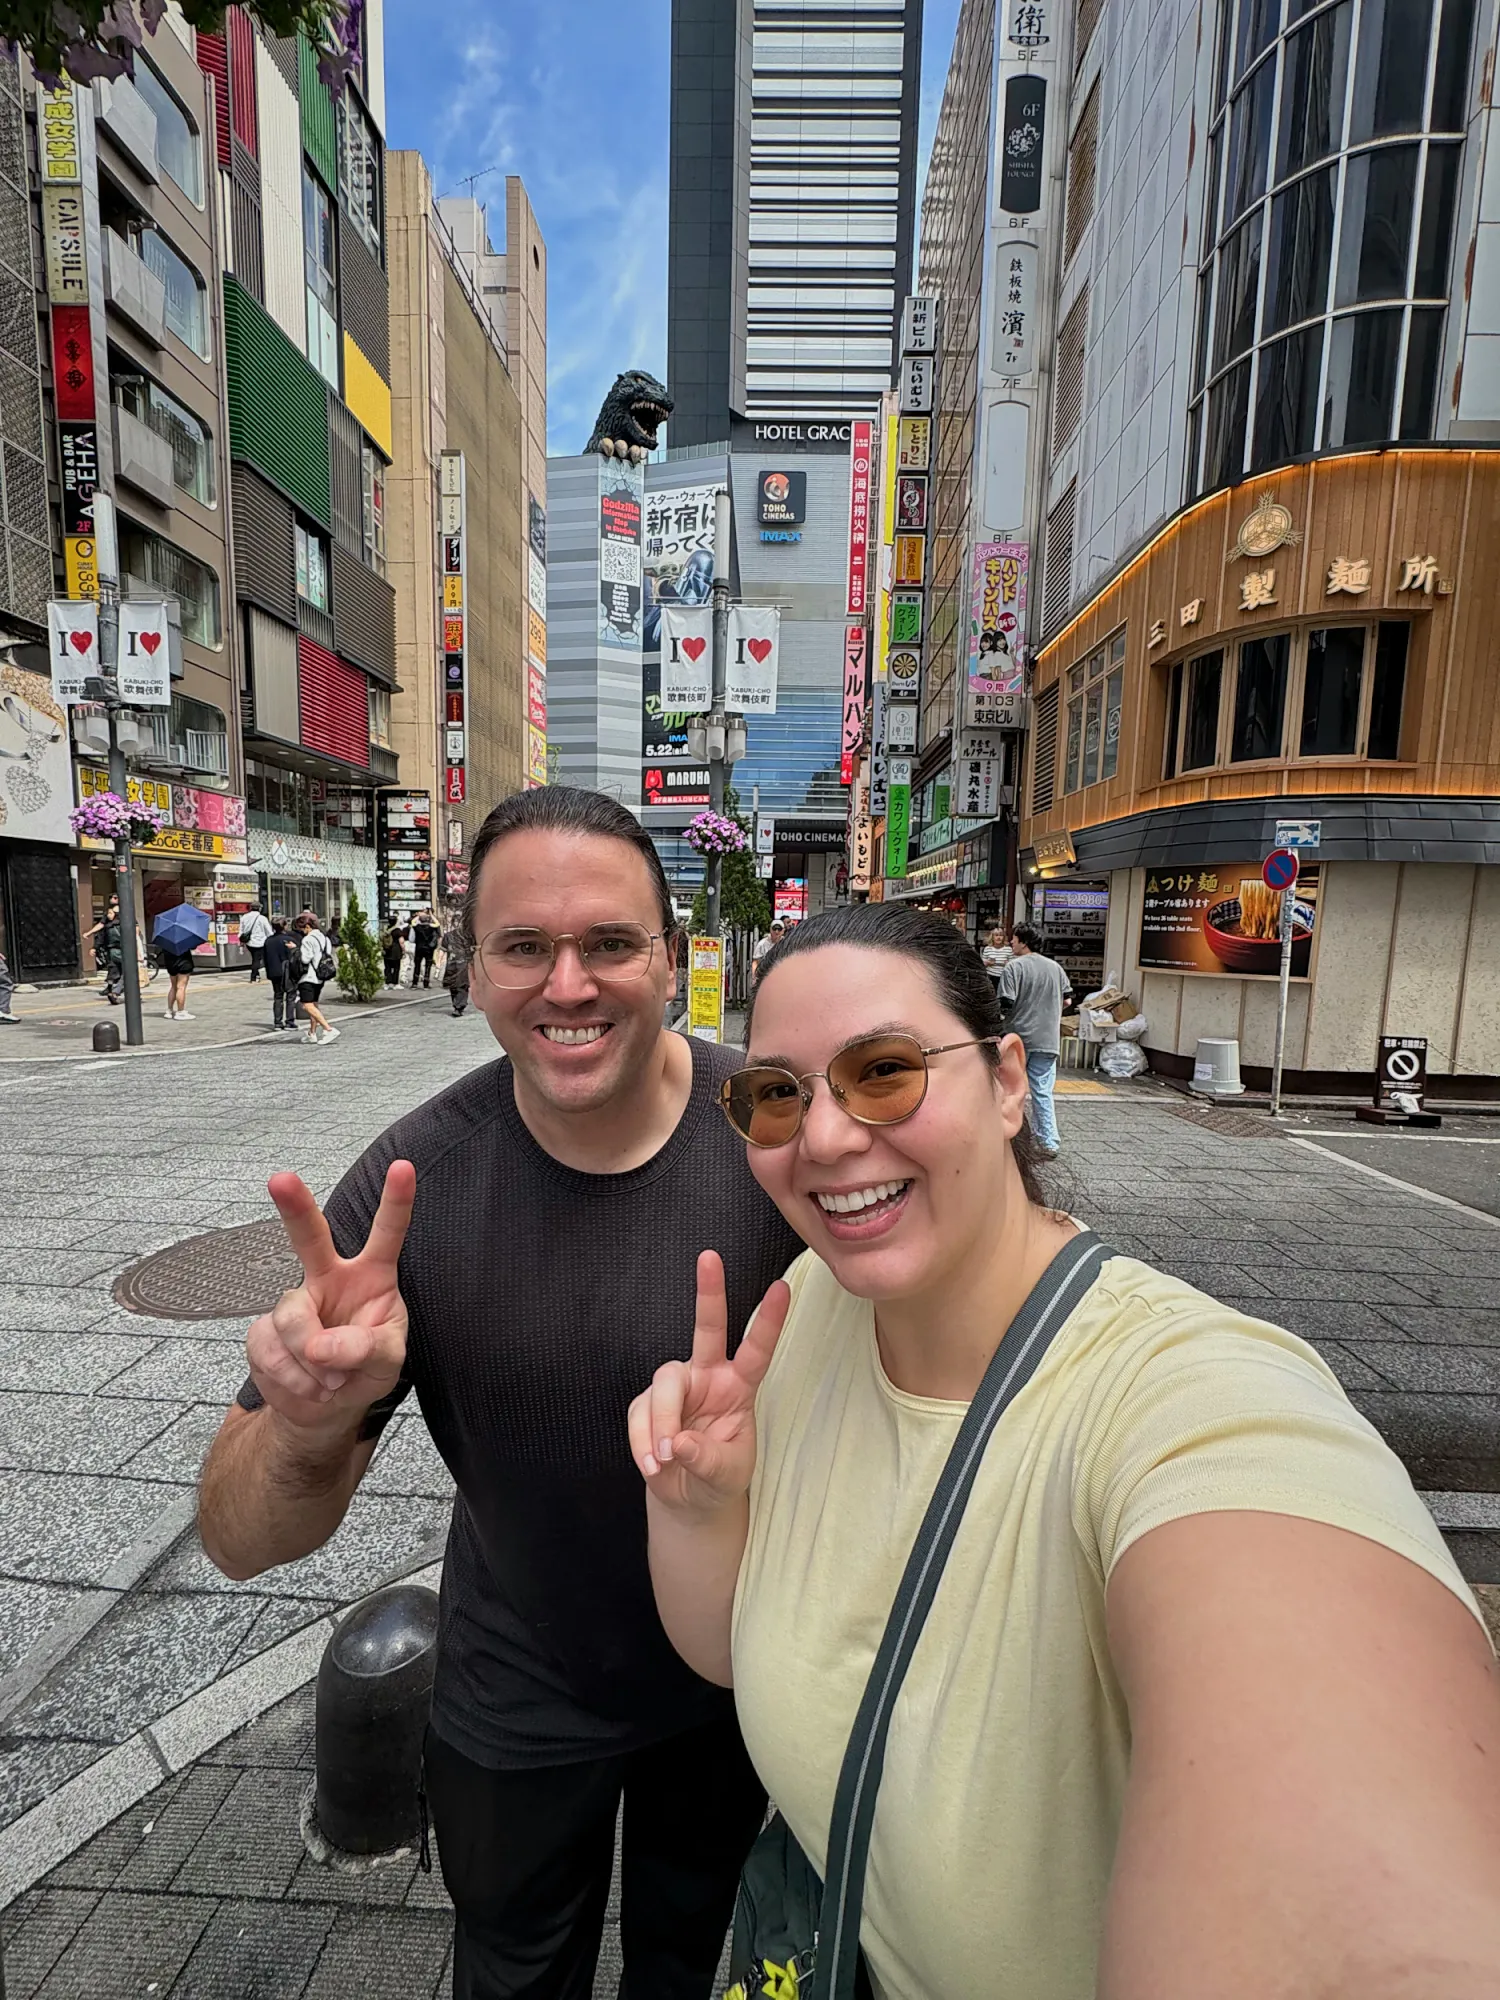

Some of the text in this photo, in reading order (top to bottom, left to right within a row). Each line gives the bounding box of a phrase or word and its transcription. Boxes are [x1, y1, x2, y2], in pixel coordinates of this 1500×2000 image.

[1014, 0, 1046, 34] 衛
[1018, 50, 1039, 61] 5F
[1022, 103, 1040, 117] 6F
[1008, 161, 1035, 169] SHISHA
[1009, 218, 1030, 228] 6F
[58, 198, 83, 290] CAPSULE
[1008, 258, 1023, 304] 鉄板焼
[912, 300, 927, 348] 川新ビル
[1001, 309, 1025, 337] 濱
[1005, 352, 1018, 363] 7F
[910, 361, 923, 407] にいむら
[1001, 378, 1021, 388] 7F
[755, 425, 851, 440] HOTEL GRAC
[63, 434, 74, 456] BAR
[910, 423, 921, 466] ととりこ
[66, 470, 77, 490] PUB
[75, 432, 96, 518] AGEHA
[603, 497, 640, 515] Godzilla
[763, 504, 786, 512] TOHO
[603, 507, 640, 522] Information
[614, 517, 628, 527] Map
[763, 512, 795, 520] CINEMAS
[76, 521, 92, 532] 2F
[607, 532, 635, 543] SCAN HERE
[760, 531, 803, 542] IMAX
[993, 534, 1013, 544] 8F
[450, 538, 460, 566] ダーツ
[1002, 559, 1018, 603] ハンド
[1146, 555, 1440, 649] 三田製麺所
[58, 631, 69, 656] I
[128, 631, 138, 656] I
[670, 637, 680, 663] I
[735, 638, 747, 664] I
[124, 684, 163, 695] 歌舞伎町
[986, 682, 1004, 692] 9階
[667, 693, 706, 702] 歌舞伎町
[731, 694, 771, 704] 歌舞伎町
[845, 646, 864, 751] マルハン
[975, 695, 1014, 706] 第103
[974, 709, 1013, 724] 東京ビル
[963, 747, 997, 757] ルノアール
[95, 770, 169, 810] 平女学園
[967, 761, 981, 813] 磯丸水産
[775, 832, 802, 842] TOHO
[1160, 872, 1219, 893] つけ麺
